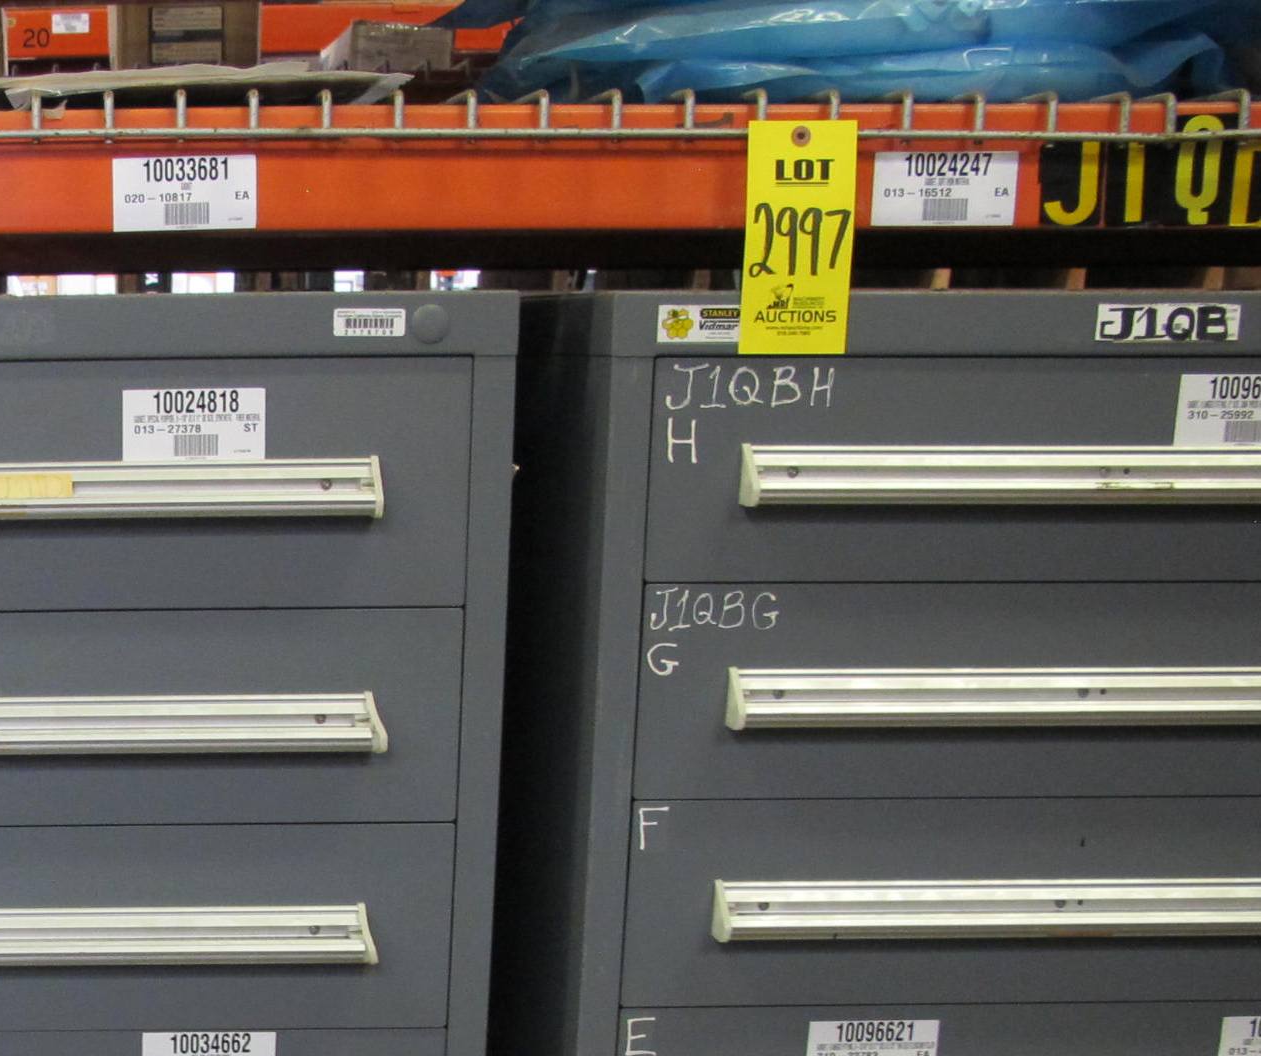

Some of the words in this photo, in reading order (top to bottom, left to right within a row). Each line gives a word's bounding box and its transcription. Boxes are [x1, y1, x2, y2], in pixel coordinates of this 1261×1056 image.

[22, 28, 51, 49] 20
[143, 157, 228, 182] 10033681
[775, 159, 835, 181] LOT
[905, 153, 993, 177] 10024247
[235, 191, 250, 200] EA
[994, 187, 1009, 197] EA
[749, 202, 851, 278] 2997
[699, 320, 739, 331] Vidmar
[702, 309, 739, 318] STANLEY
[754, 310, 837, 323] AUCTIONS
[1100, 305, 1228, 342] J1QB
[665, 363, 835, 410] J1QBH
[153, 390, 239, 414] 10024818
[243, 423, 258, 433] ST
[667, 417, 698, 463] H
[650, 587, 780, 632] J1QBG
[647, 642, 680, 676] G
[639, 806, 670, 851] F
[170, 1033, 251, 1054] 10034662
[625, 1016, 657, 1056] E
[836, 1021, 915, 1043] 10096621
